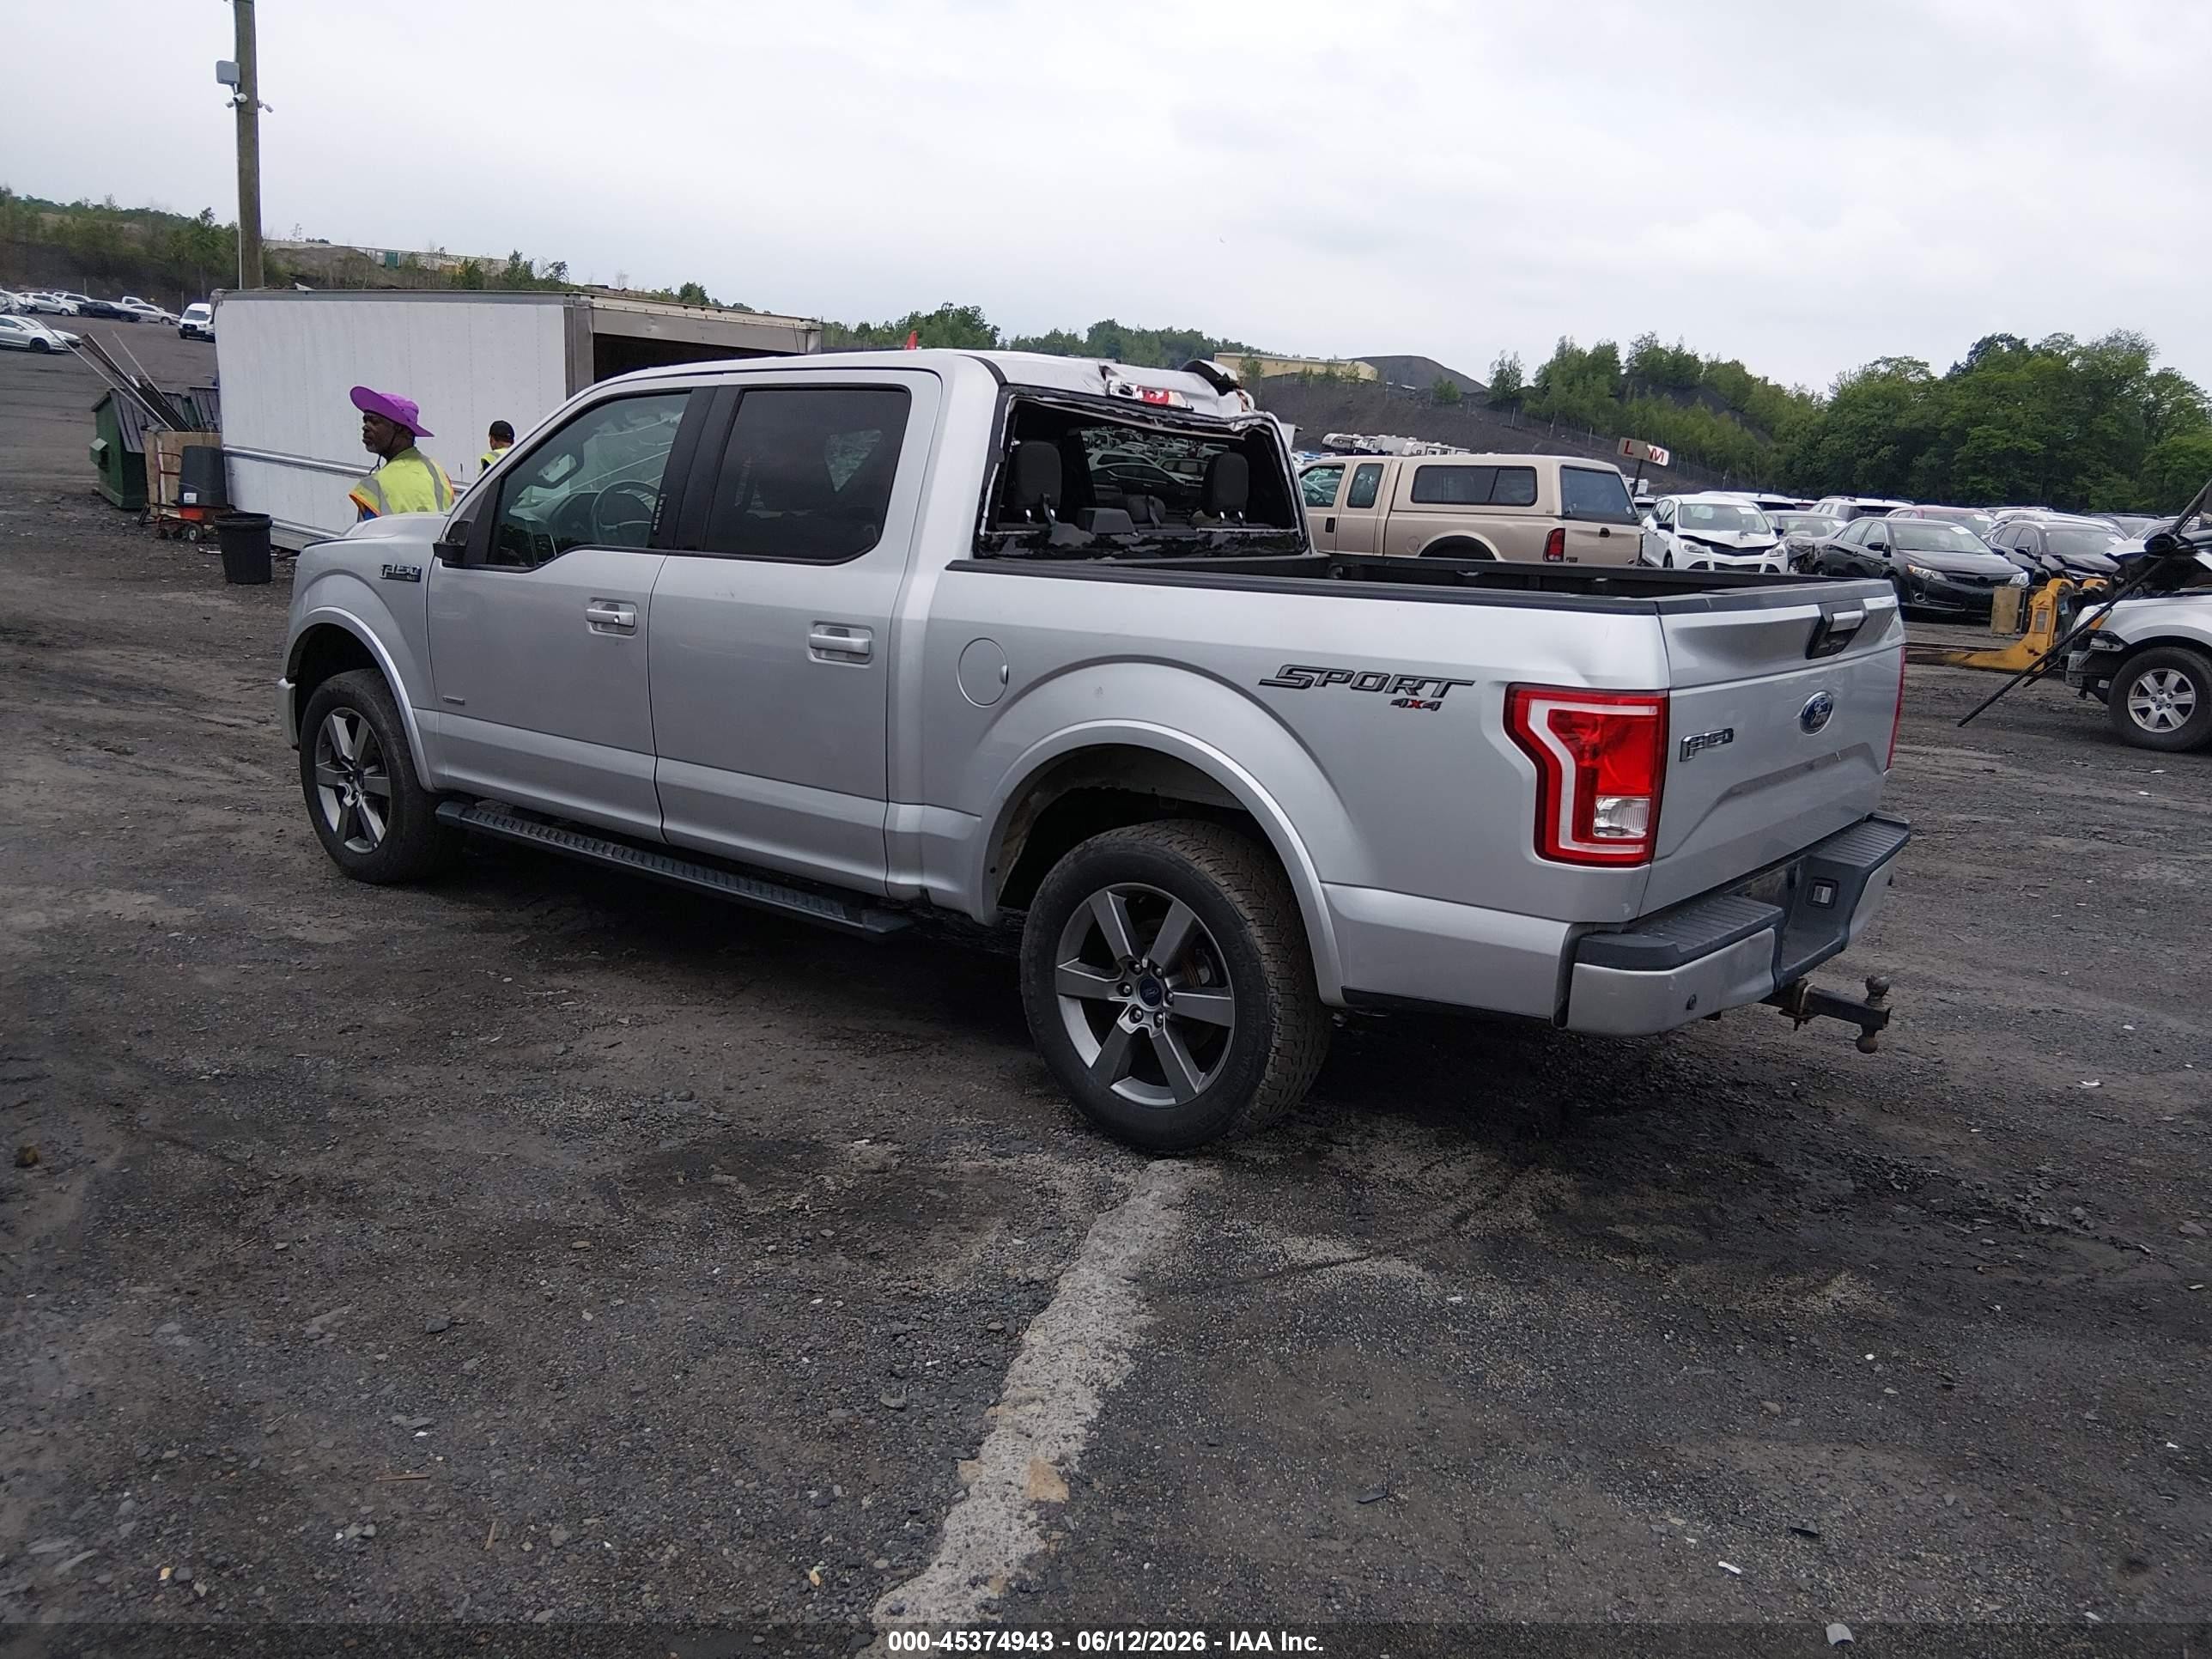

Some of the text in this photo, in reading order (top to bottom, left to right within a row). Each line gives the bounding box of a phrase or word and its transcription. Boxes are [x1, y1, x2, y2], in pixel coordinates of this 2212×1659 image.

[1624, 440, 1665, 464] L M
[1258, 664, 1476, 699] SPORT
